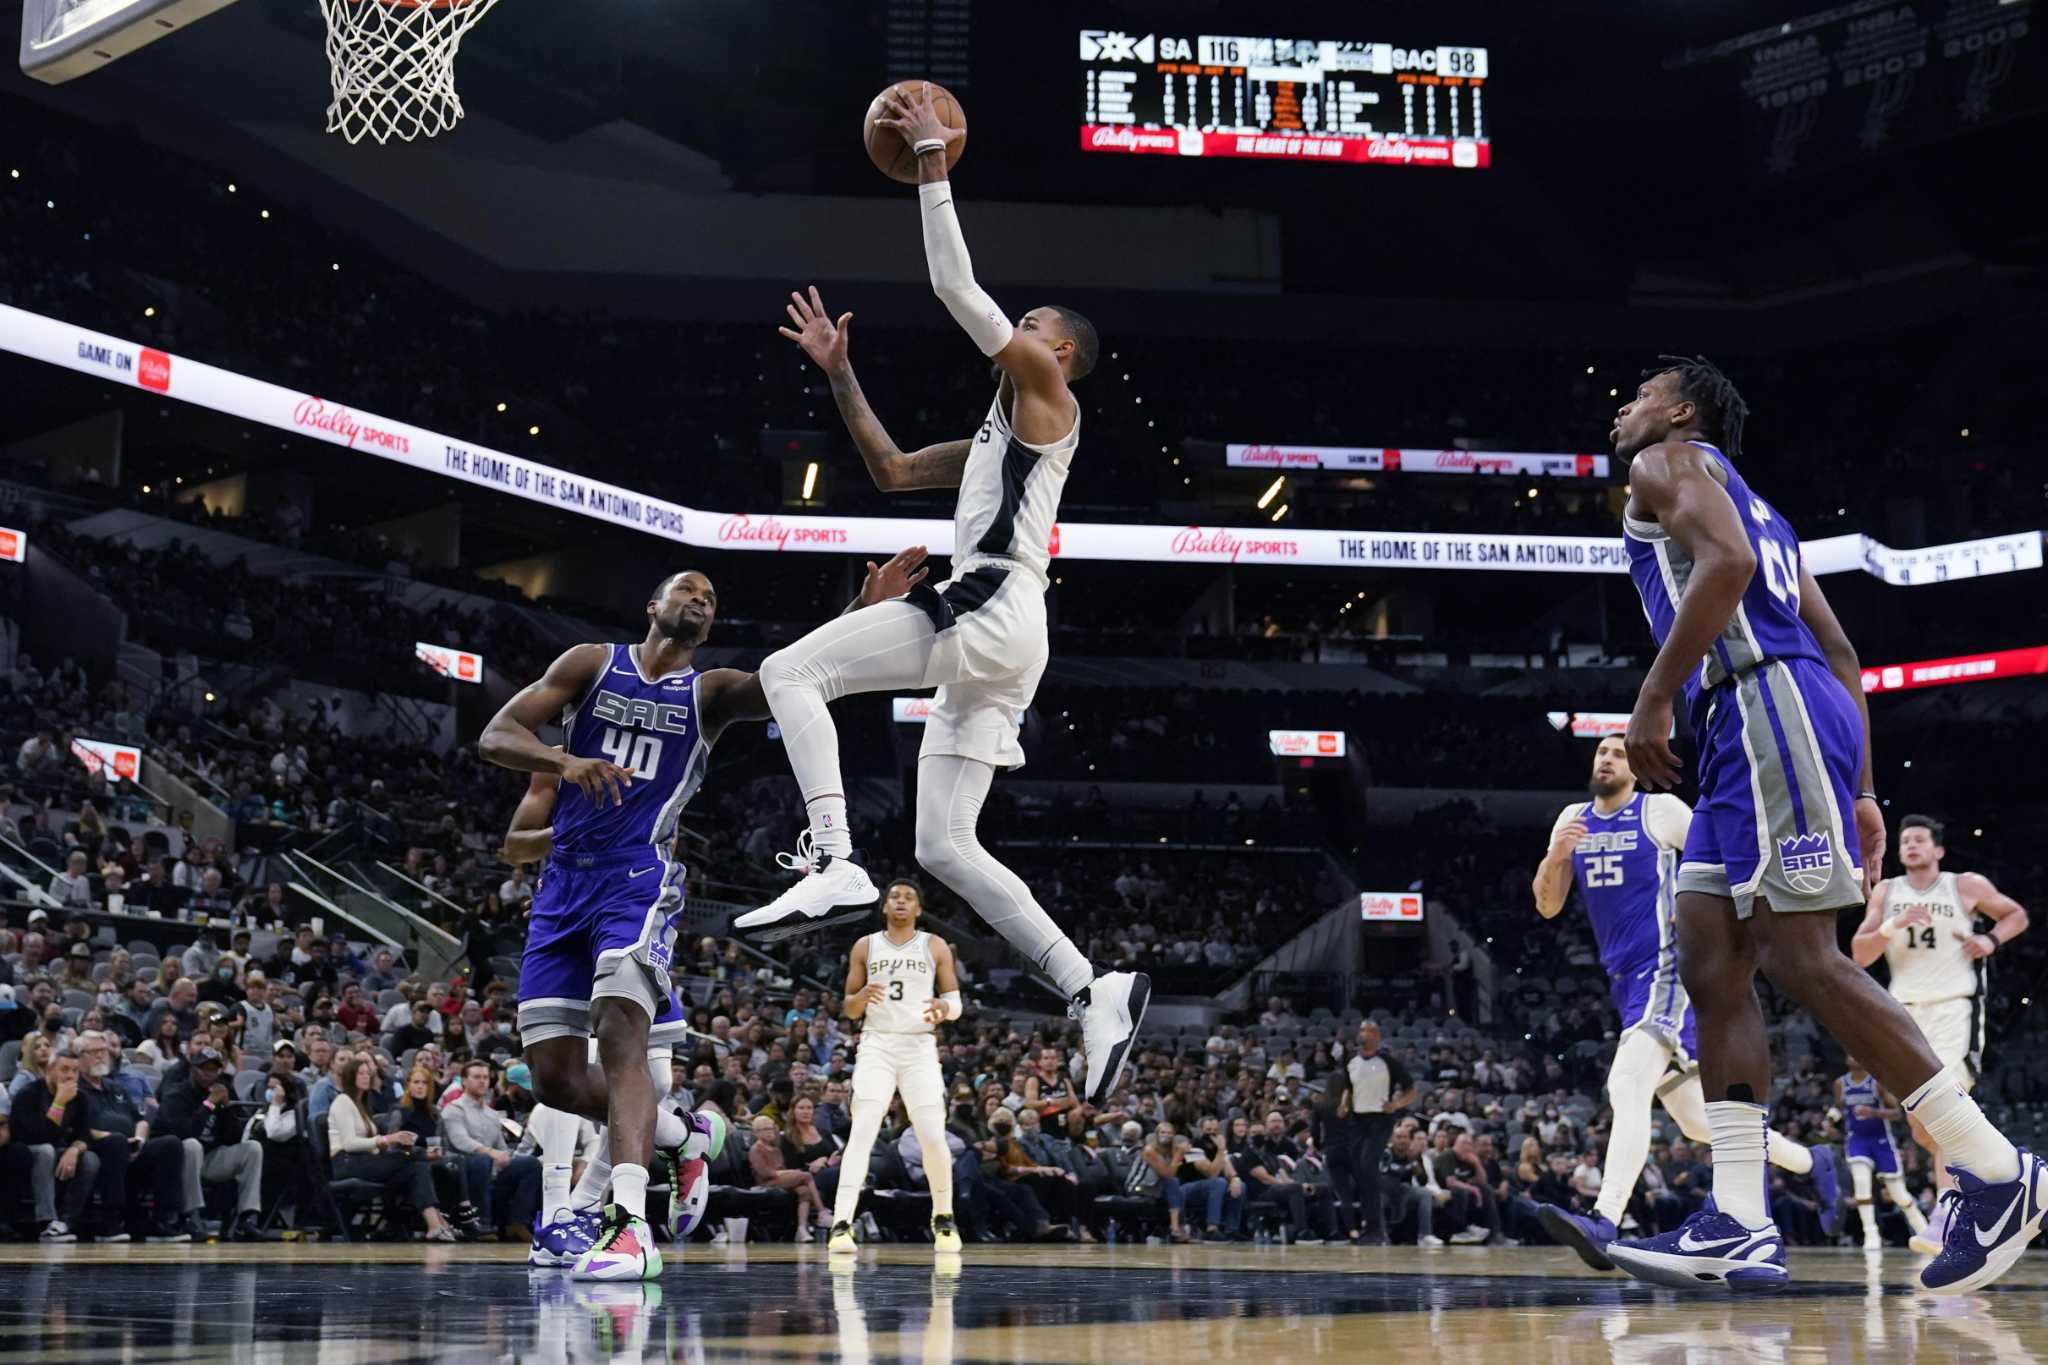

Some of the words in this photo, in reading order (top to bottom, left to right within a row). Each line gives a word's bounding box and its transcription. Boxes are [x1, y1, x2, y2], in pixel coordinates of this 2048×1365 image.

[1160, 37, 1192, 60] SA
[1210, 41, 1239, 63] 116
[1392, 48, 1437, 71] SAC
[1450, 52, 1475, 73] 98
[78, 341, 113, 367] GAME
[116, 352, 132, 372] ON
[293, 396, 361, 448] Bally
[362, 425, 410, 454] SPORTS
[1241, 443, 1284, 468] Bally
[445, 444, 468, 473] THE
[472, 452, 511, 486] HOME
[514, 466, 531, 491] OF
[533, 472, 557, 498] THE
[560, 479, 585, 507] SAN
[589, 488, 643, 525] ANTONIO
[645, 504, 685, 535] SPURS
[718, 512, 791, 551] Bally
[793, 528, 847, 544] SPORTS
[1171, 525, 1242, 562] Bally
[1245, 541, 1298, 556] SPORTS
[1339, 538, 1366, 560] THE
[1371, 539, 1418, 561] HOME
[1423, 540, 1442, 562] OF
[1445, 541, 1473, 562] THE
[1477, 541, 1511, 564] SAN
[1514, 542, 1584, 565] ANTONIO
[1590, 544, 1631, 567] SPUR
[592, 689, 689, 735] SAC
[601, 727, 663, 781] 40
[1575, 830, 1638, 854] SAC
[1584, 855, 1624, 888] 25
[1783, 853, 1831, 871] SAC
[1893, 902, 1954, 918] SRS
[1907, 926, 1936, 949] 14
[870, 959, 927, 976] SPURS
[889, 980, 903, 1001] 3
